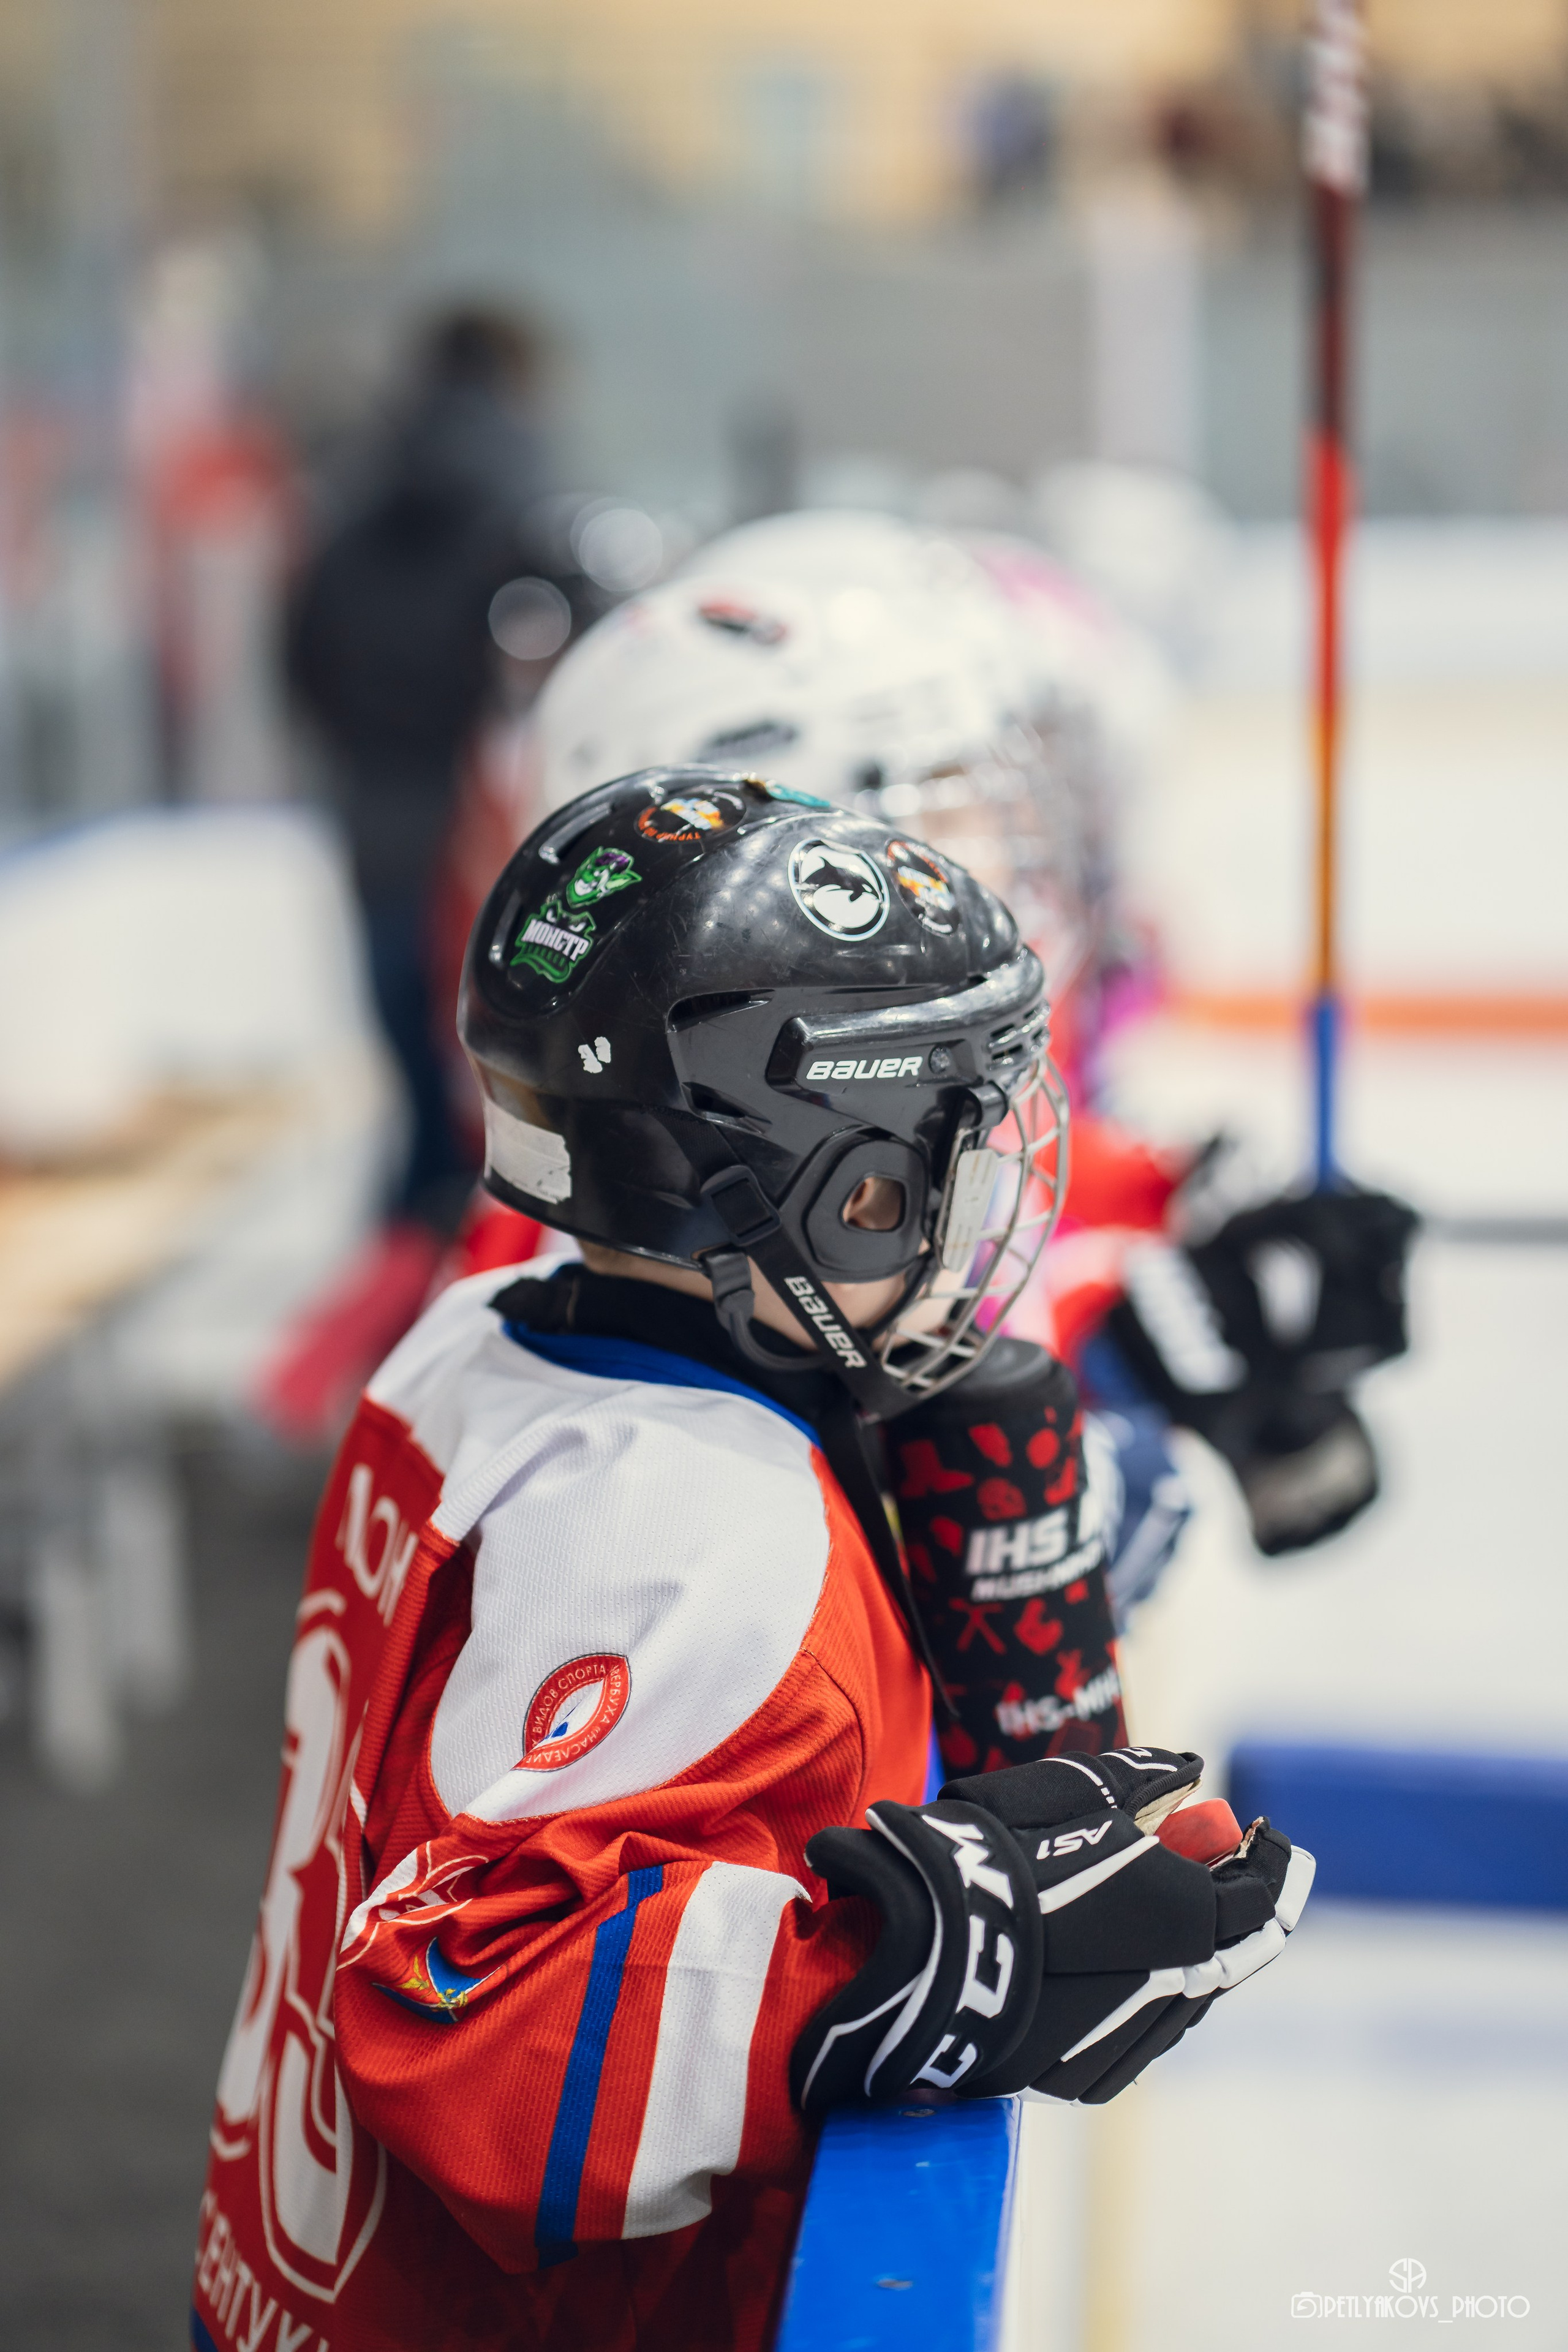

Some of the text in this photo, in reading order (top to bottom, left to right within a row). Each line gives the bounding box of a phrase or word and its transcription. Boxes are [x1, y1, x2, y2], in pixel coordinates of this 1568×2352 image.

[521, 919, 589, 961] МОНСТР
[806, 1056, 924, 1080] BAUER
[784, 1276, 867, 1368] BAUER
[532, 1664, 606, 1734] ВИДОВ СПОРТА
[1036, 1820, 1113, 1860] AS1
[909, 1813, 1014, 2089] CCM
